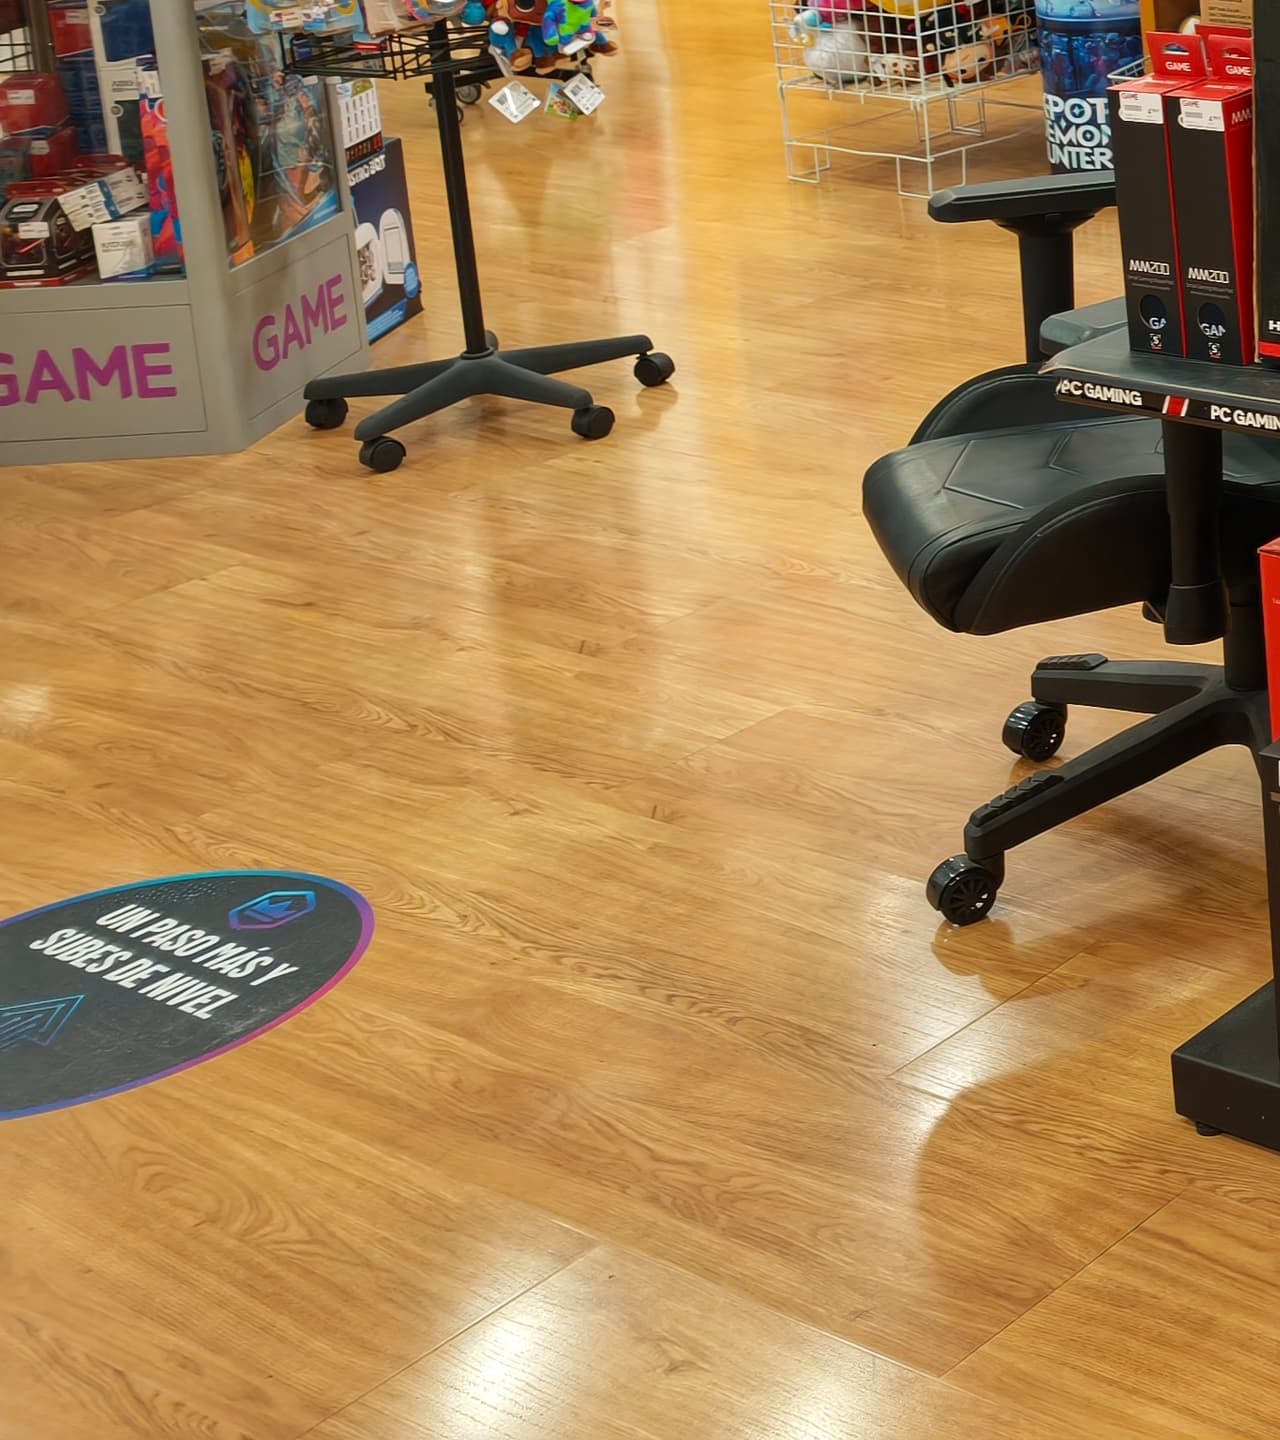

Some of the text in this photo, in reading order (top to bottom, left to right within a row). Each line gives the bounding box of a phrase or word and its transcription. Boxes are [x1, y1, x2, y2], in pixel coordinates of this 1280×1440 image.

[1129, 260, 1170, 276] MM200
[1188, 267, 1230, 284] MM200
[252, 273, 347, 371] GAME
[1057, 377, 1143, 410] PC GAMING
[1209, 405, 1231, 427] PC
[96, 904, 299, 986] UN PASO MÁS Y
[30, 929, 239, 1020] SUBES DE NIVEL
